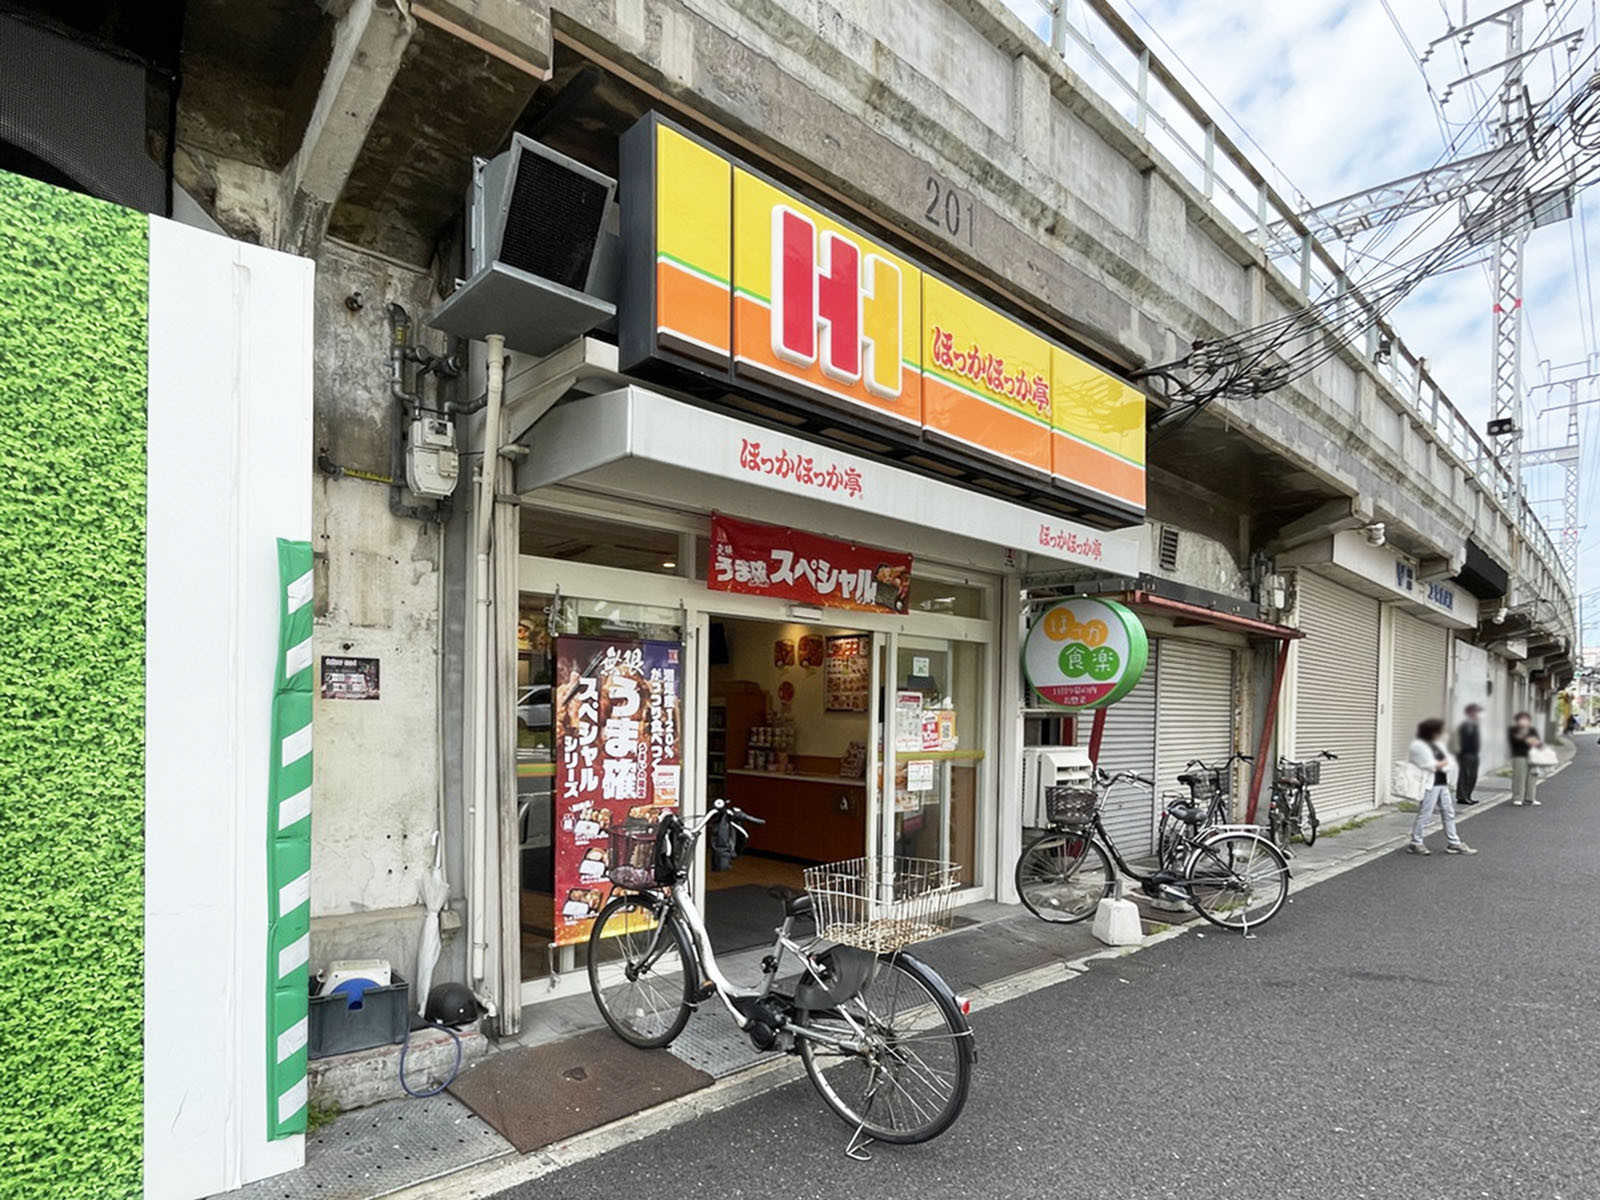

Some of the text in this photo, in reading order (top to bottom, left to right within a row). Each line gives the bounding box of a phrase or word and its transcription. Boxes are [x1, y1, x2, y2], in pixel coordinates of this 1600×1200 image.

[925, 176, 974, 247] 201
[932, 325, 1050, 412] ほっかほっか亭
[740, 438, 862, 498] ほっかほっか亭
[1039, 523, 1103, 561] ほっかほっか亭
[1051, 614, 1103, 643] ほっか
[1065, 645, 1115, 673] 食楽
[578, 677, 600, 792] スペシャル
